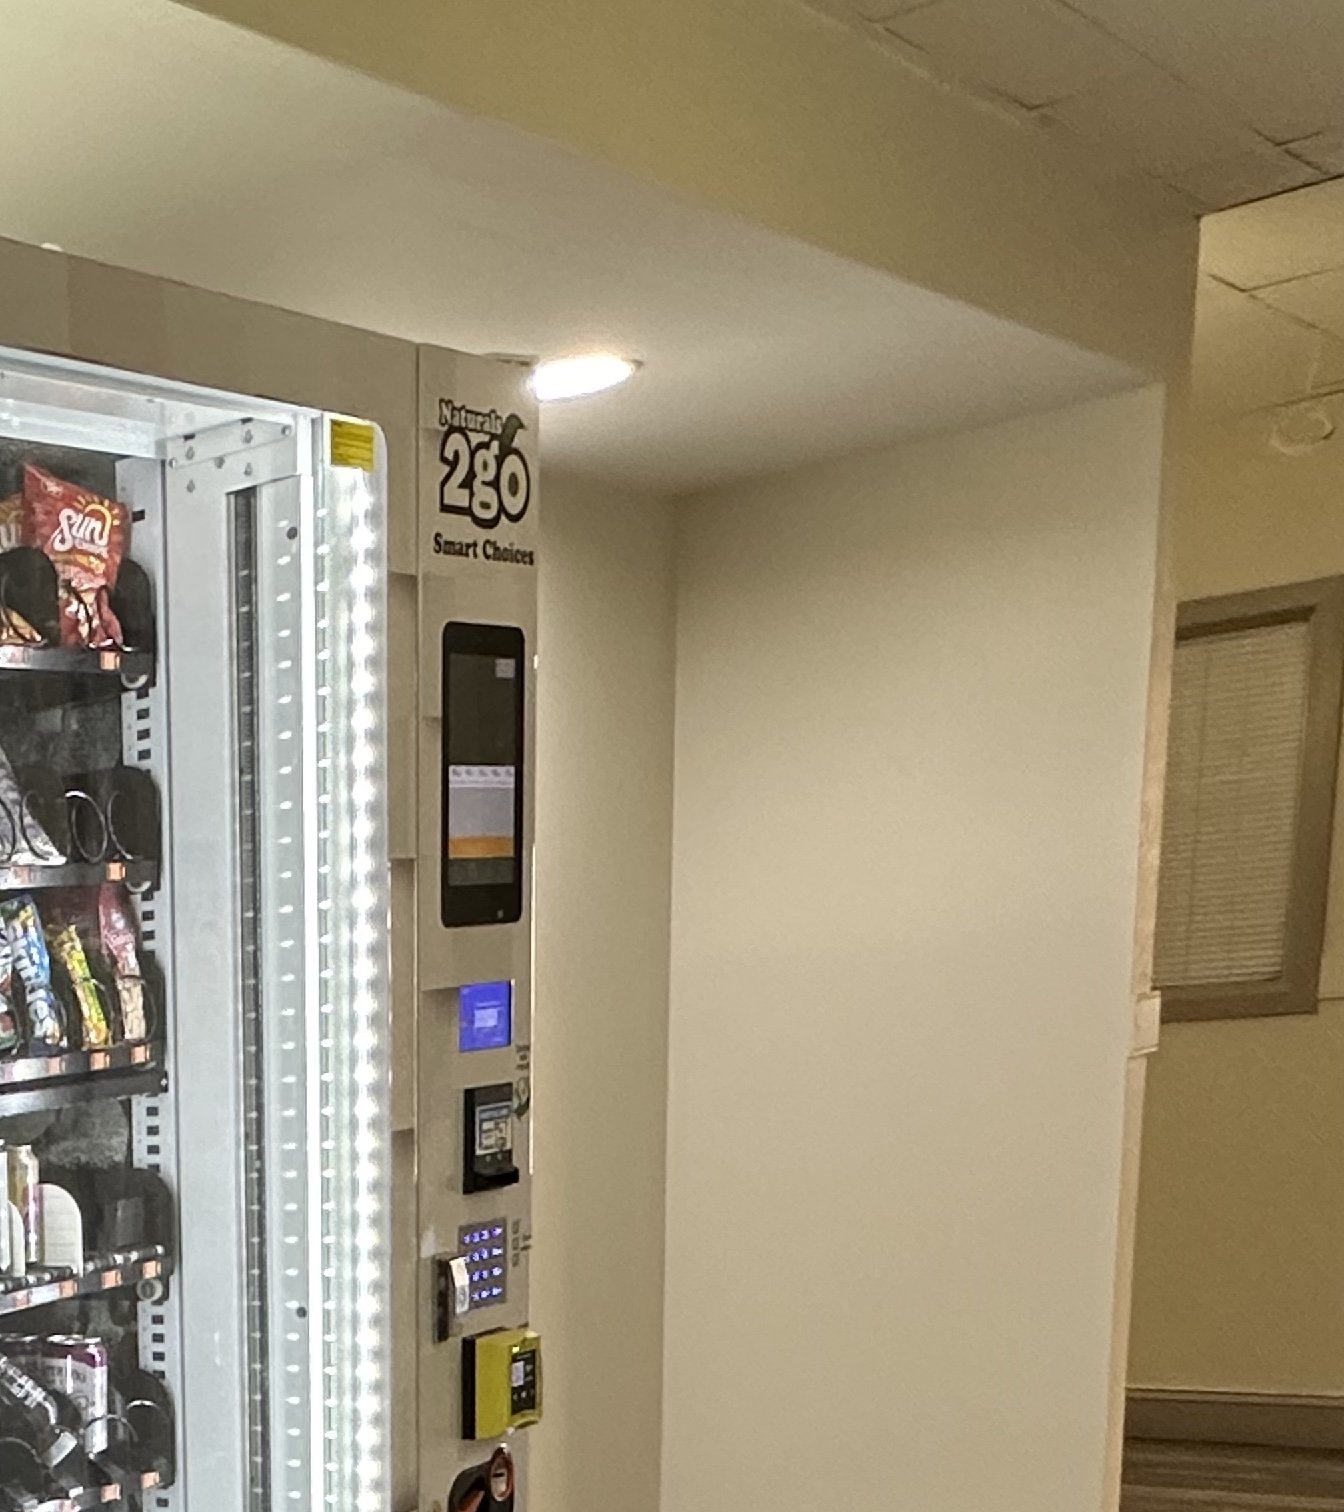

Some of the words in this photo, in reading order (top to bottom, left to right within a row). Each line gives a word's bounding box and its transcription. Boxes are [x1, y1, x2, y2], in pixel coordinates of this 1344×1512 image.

[438, 398, 503, 435] Naturals
[439, 426, 530, 529] 2go
[433, 532, 479, 559] Smart
[483, 538, 535, 566] Choices
